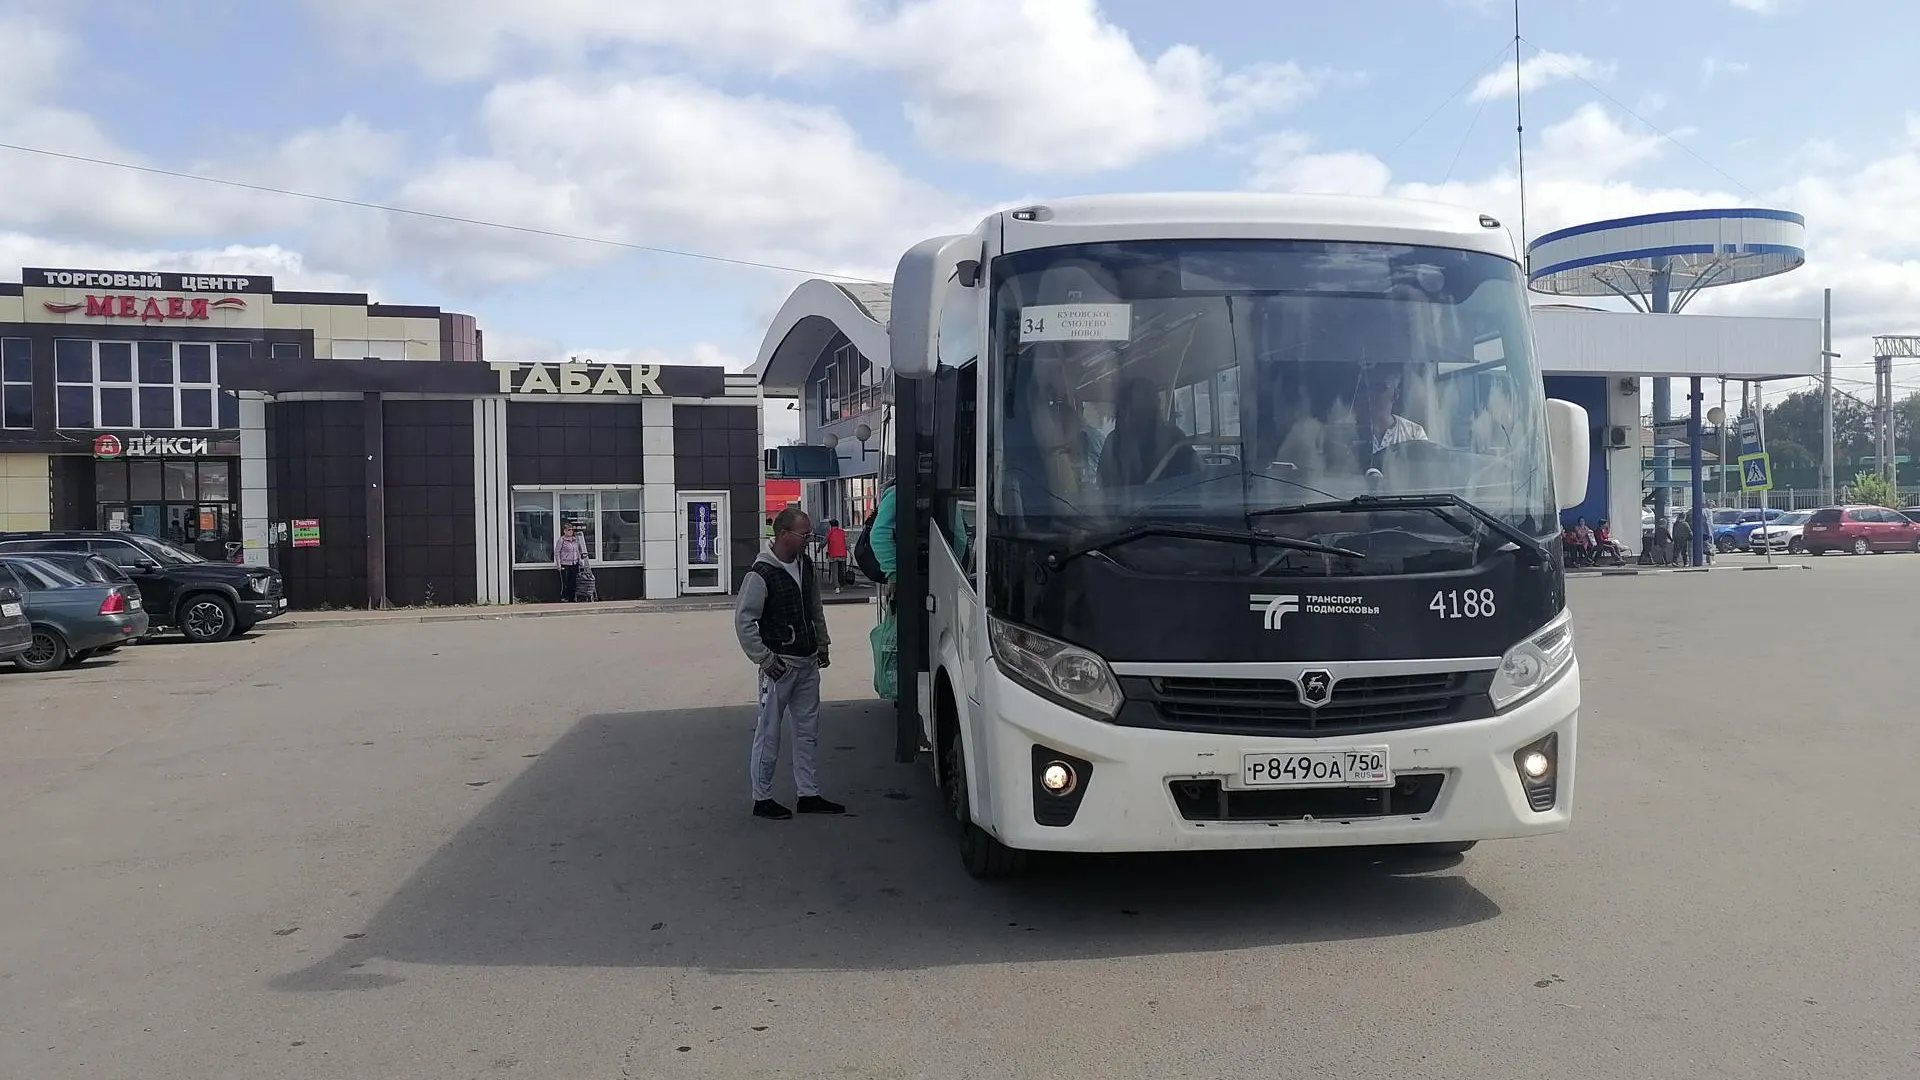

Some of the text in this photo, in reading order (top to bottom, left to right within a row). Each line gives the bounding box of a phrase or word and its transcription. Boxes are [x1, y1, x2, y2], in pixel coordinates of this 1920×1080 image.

[44, 271, 249, 291] ТОРГОВЫЙ ЦЕНТР
[85, 295, 209, 322] МЕДЕЯ
[1023, 318, 1045, 335] 34
[490, 361, 664, 395] ТАБАК
[126, 437, 208, 456] ДИКСИ
[1306, 595, 1363, 604] ТРАНСПОРТ
[1429, 588, 1496, 619] 4188
[1306, 605, 1380, 614] ПОДМОСКОВЬЯ
[1346, 754, 1380, 772] 750
